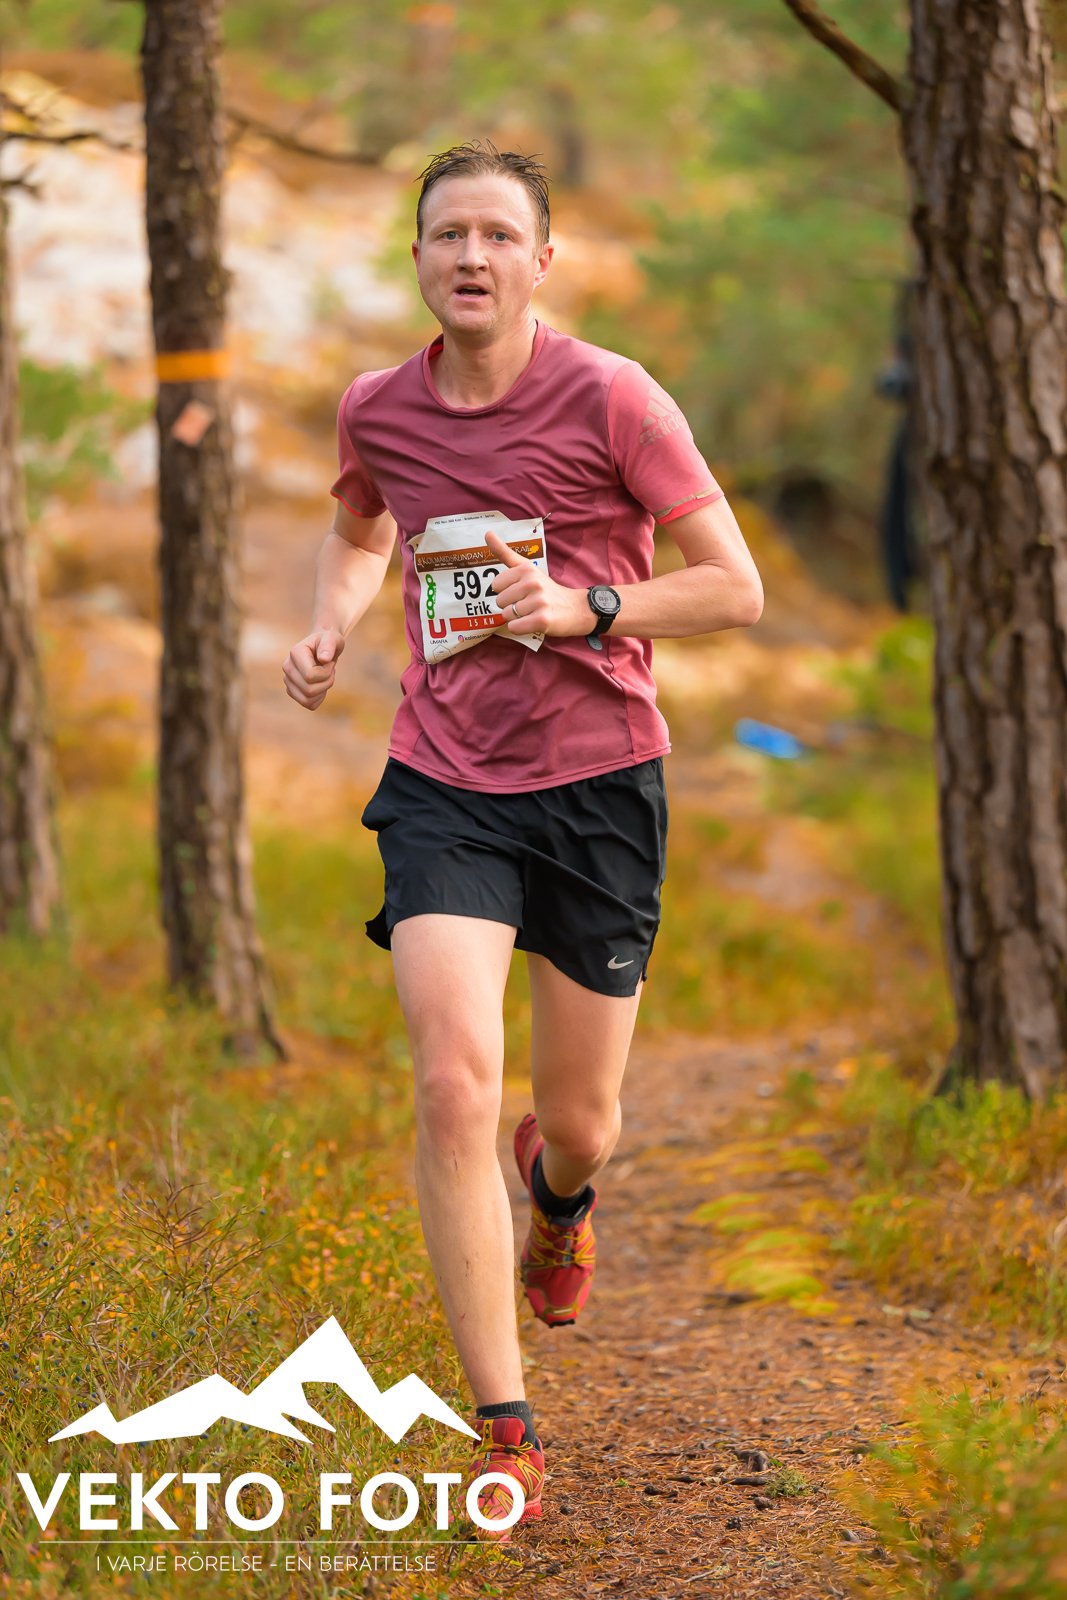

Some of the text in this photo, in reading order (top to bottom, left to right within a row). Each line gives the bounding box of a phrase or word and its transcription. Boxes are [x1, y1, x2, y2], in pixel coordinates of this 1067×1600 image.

[453, 568, 500, 600] 592
[465, 601, 492, 616] Erik
[468, 617, 495, 627] 15 KM
